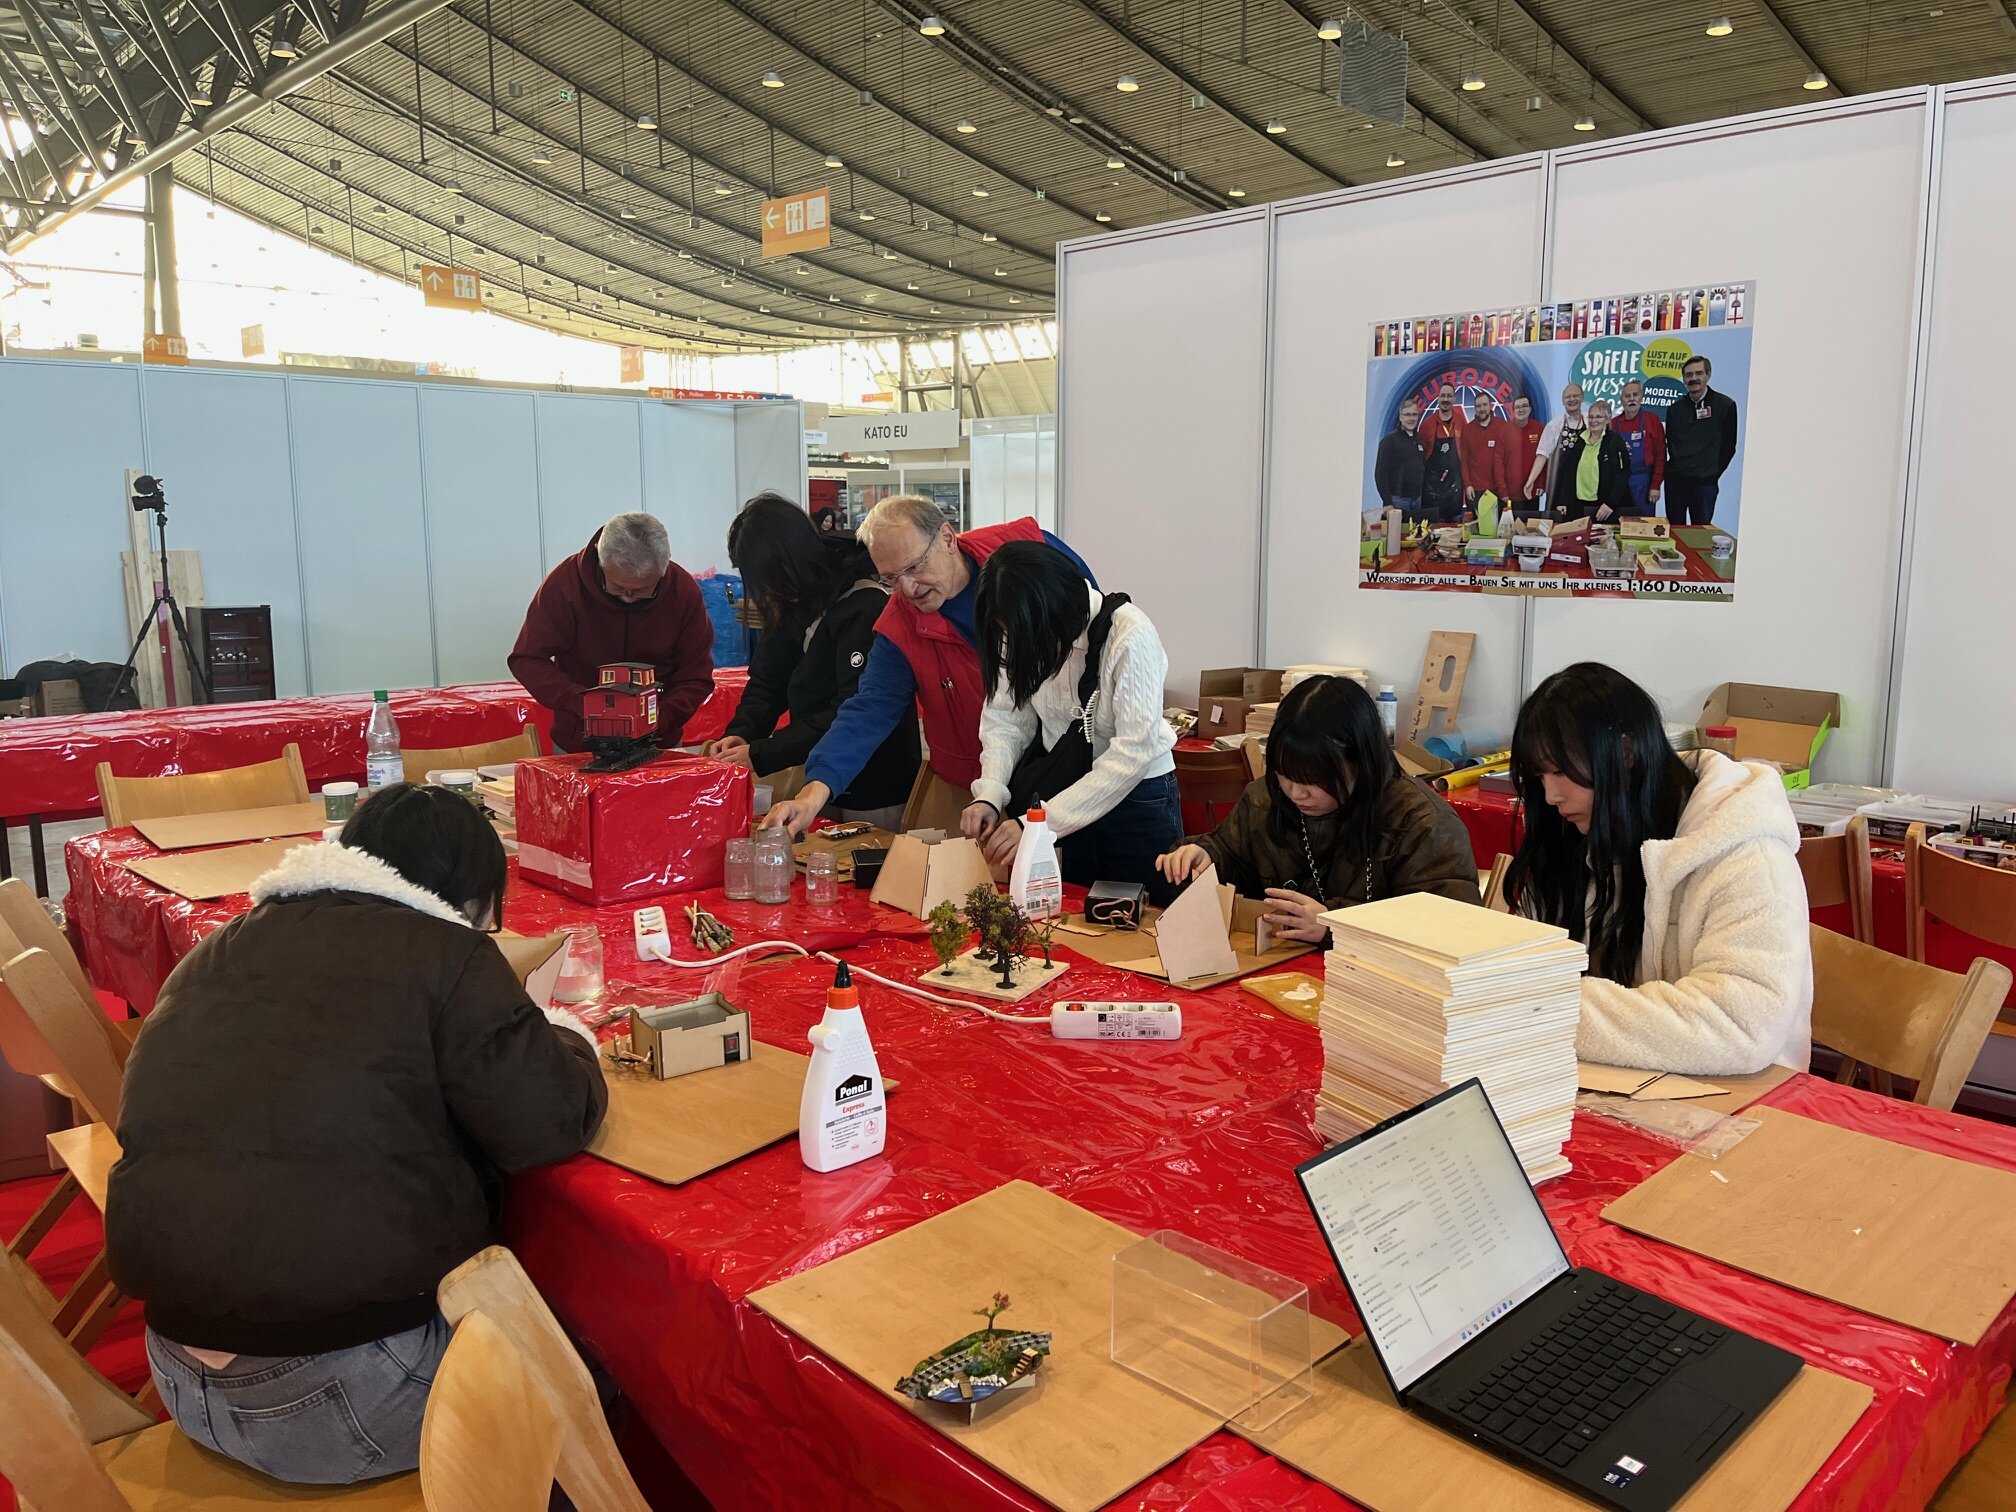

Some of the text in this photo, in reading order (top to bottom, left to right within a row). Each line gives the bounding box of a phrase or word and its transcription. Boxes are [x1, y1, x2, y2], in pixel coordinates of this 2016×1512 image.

[1647, 350, 1688, 361] LUST AUF
[1644, 387, 1683, 399] MODELL-
[864, 424, 908, 440] KATO EU
[1627, 579, 1665, 593] 1:160
[840, 1079, 868, 1099] Ponal
[842, 1102, 865, 1114] Express
